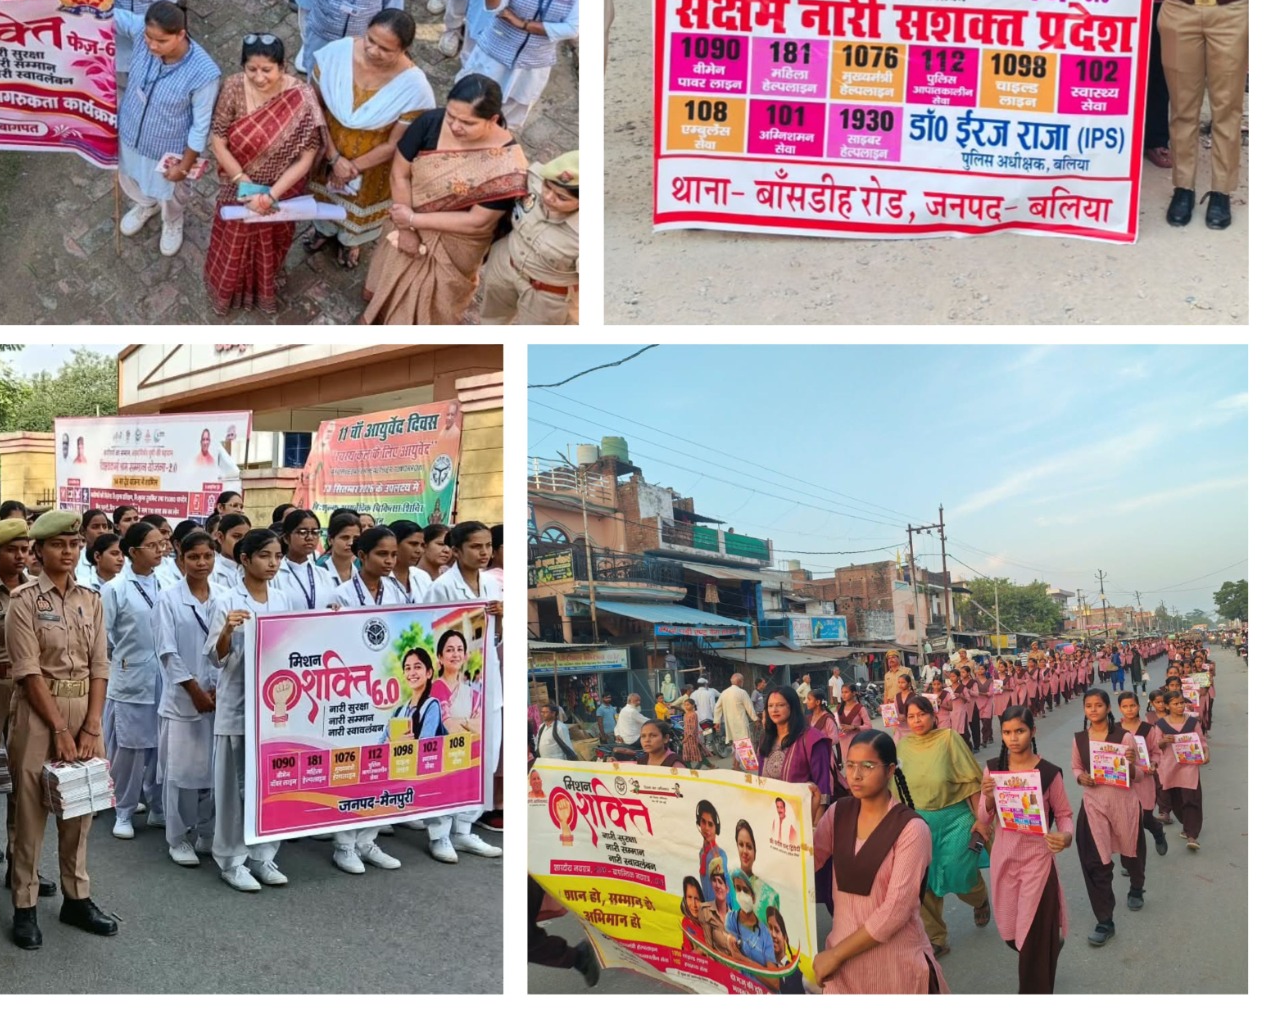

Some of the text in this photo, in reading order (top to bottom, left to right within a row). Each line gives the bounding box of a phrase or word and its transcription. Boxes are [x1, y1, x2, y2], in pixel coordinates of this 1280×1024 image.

[894, 4, 1029, 48] सशक्त
[1035, 1, 1138, 54] प्रदेश
[11, 49, 45, 61] सुरक्षा
[680, 36, 741, 61] 1090
[768, 40, 812, 64] 181
[841, 44, 898, 69] 1076
[13, 60, 56, 73] सम्मान
[921, 49, 975, 73] 112
[990, 52, 1046, 79] 1098
[1075, 59, 1118, 82] 102
[16, 70, 74, 86] स्वावलंबन
[771, 68, 808, 80] महिला
[677, 78, 742, 90] पावर लाइन
[762, 80, 817, 94] हेल्पलाइन
[1070, 86, 1118, 100] स्वास्थ्य
[684, 100, 728, 122] 108
[766, 104, 805, 126] 101
[1080, 100, 1106, 112] सेवा
[840, 108, 894, 132] 1930
[846, 134, 882, 146] साइबर
[955, 109, 1010, 151] ईरज
[1016, 120, 1070, 152] राजा
[1076, 126, 1124, 154] (IPS)
[960, 148, 1090, 172] पुलिस अधीक्षक, बलिया
[754, 168, 854, 217] बाँसडीह
[1027, 184, 1114, 224] बलिया
[364, 412, 440, 442] आयुर्वेद दिवस
[289, 652, 322, 669] मिशन
[300, 650, 400, 724] शक्ति 6.0
[394, 744, 414, 757] 1098
[422, 740, 438, 752] 102
[449, 736, 464, 748] 108
[272, 756, 296, 770] 1090
[307, 755, 322, 766] 181
[334, 751, 356, 764] 1076
[368, 747, 382, 760] 112
[562, 776, 592, 793] मिशन
[576, 777, 654, 848] शक्ति
[564, 887, 588, 902] शान
[608, 892, 642, 910] सम्मान
[582, 908, 642, 929] अभिमान हो
